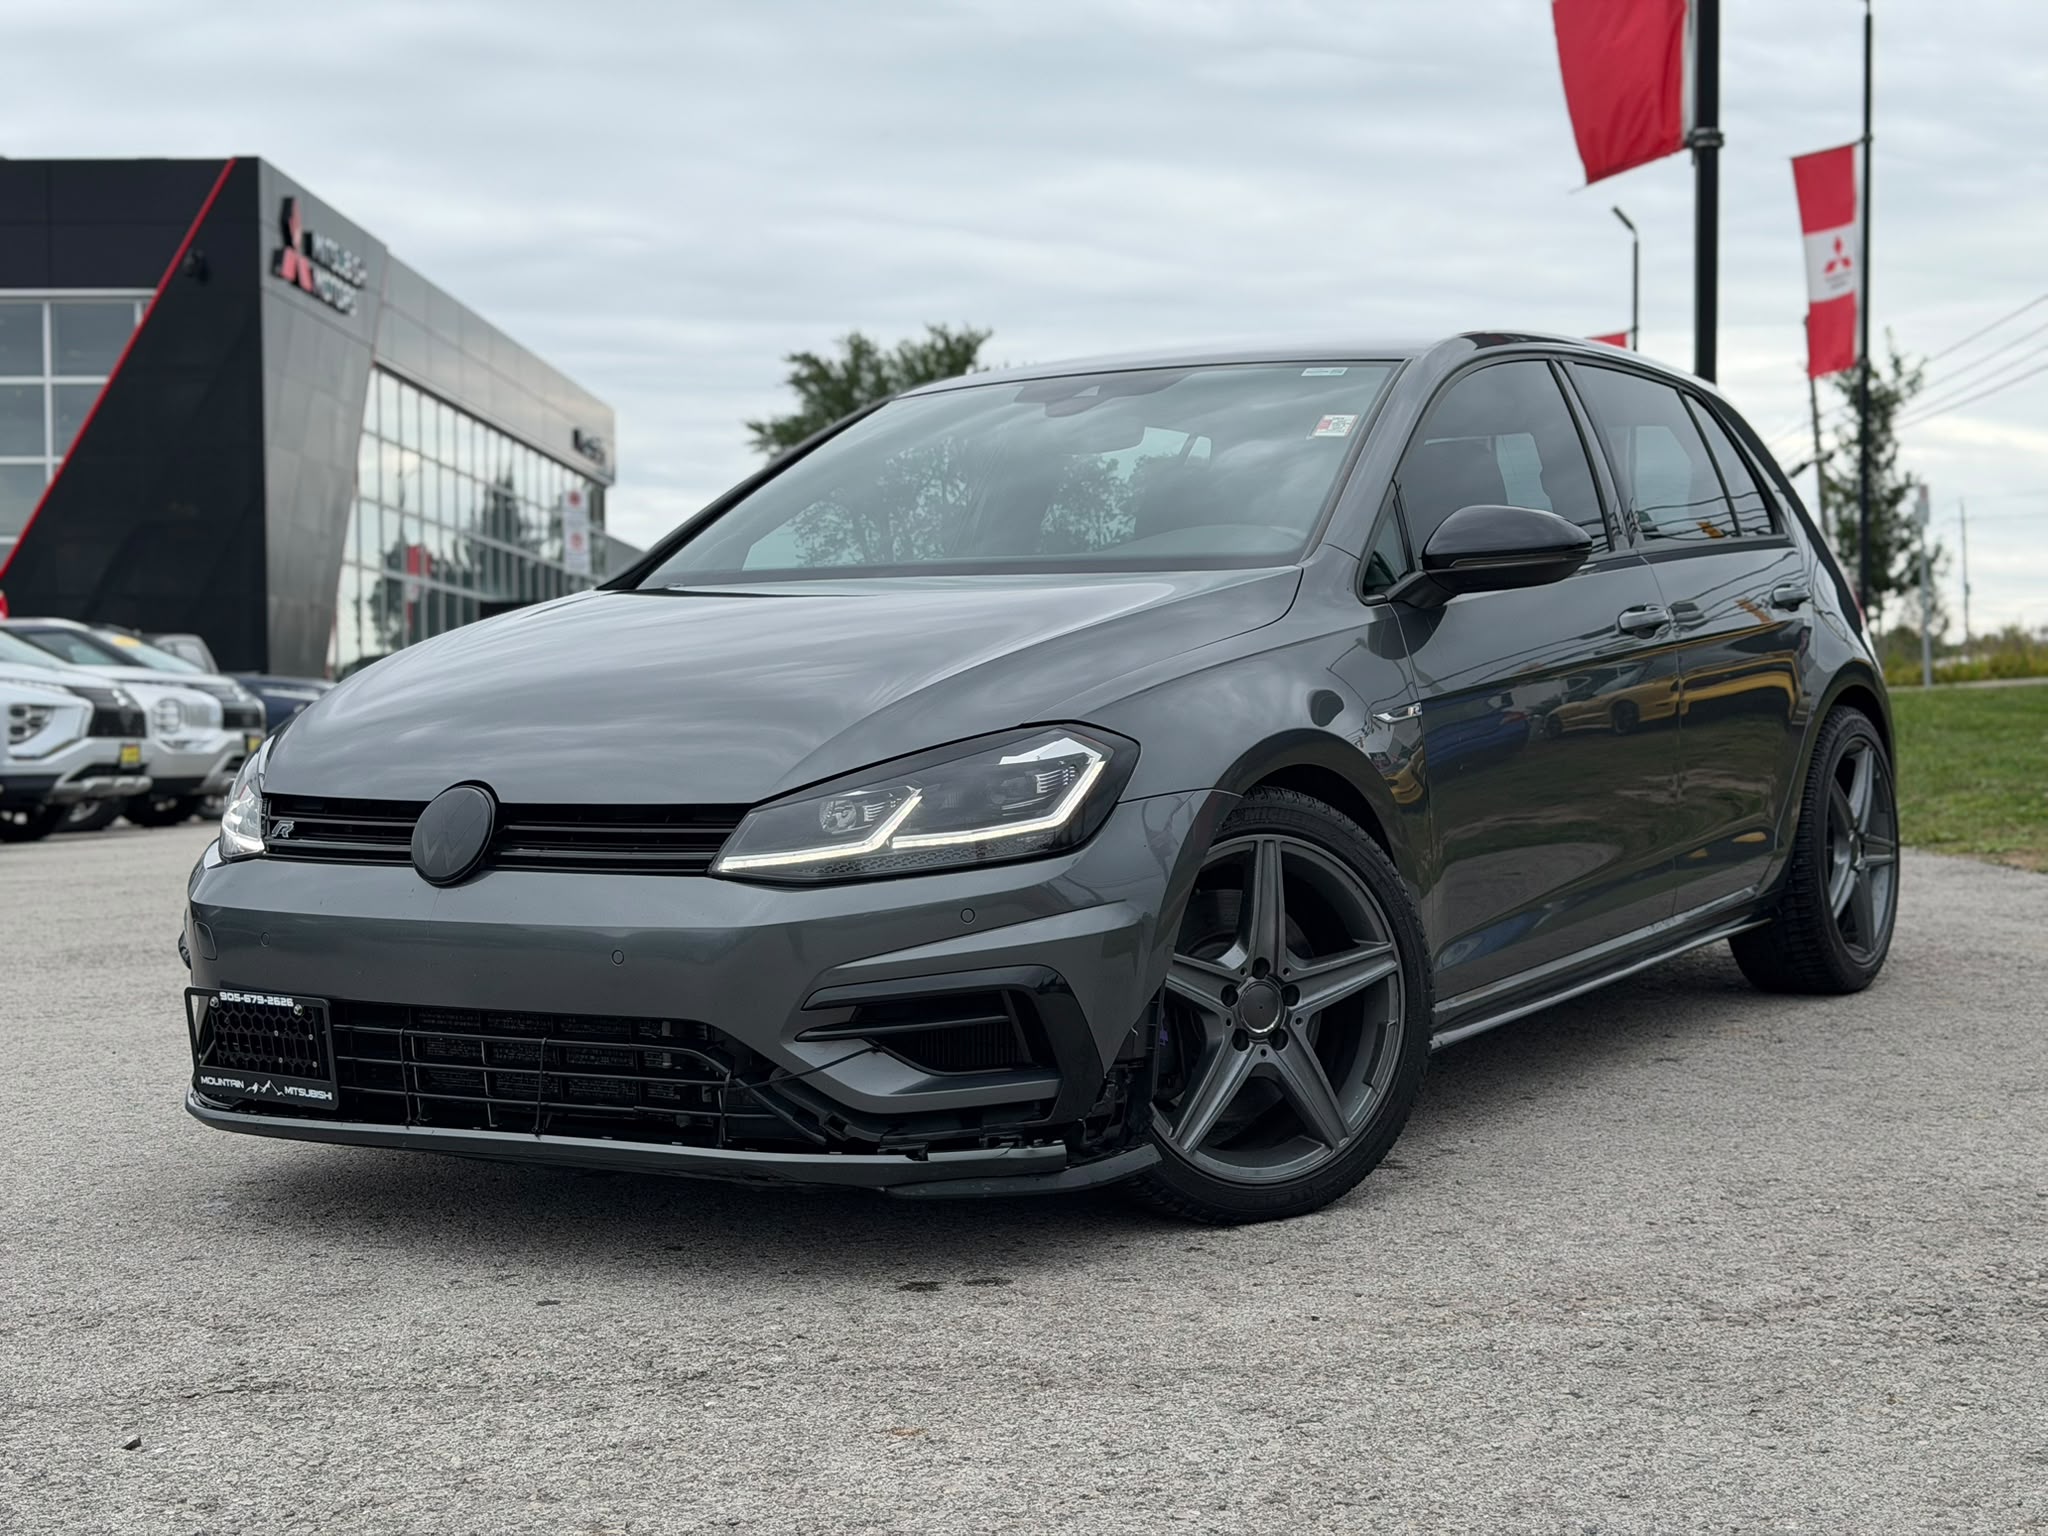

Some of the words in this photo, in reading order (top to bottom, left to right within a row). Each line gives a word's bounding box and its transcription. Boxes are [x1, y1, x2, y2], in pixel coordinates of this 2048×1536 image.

[271, 819, 295, 838] R
[219, 991, 294, 1008] 905-679-2626
[200, 1075, 245, 1089] MOUNTAIN
[284, 1085, 333, 1101] MITSUBISHI
